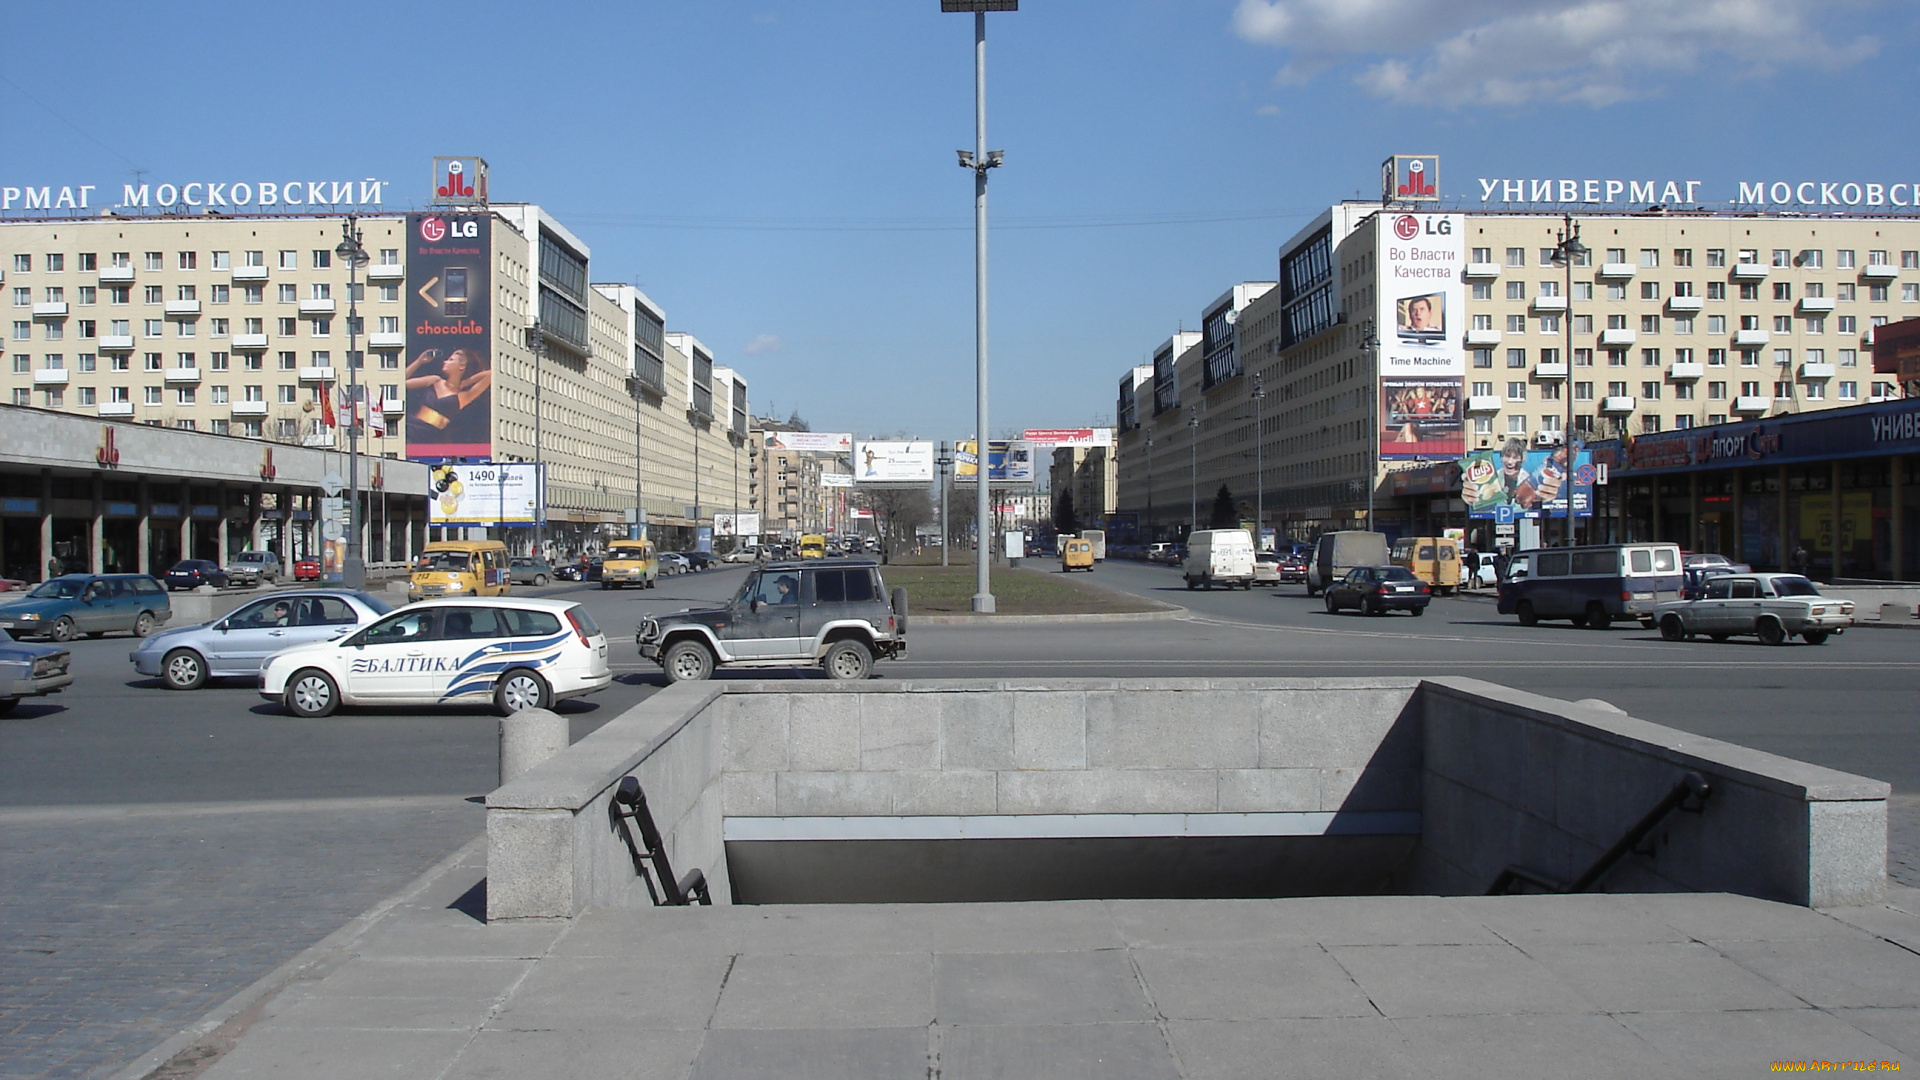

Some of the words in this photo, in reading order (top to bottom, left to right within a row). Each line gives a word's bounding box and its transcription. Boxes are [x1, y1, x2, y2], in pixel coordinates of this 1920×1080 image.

[2, 185, 96, 210] РМАГ
[1478, 178, 1701, 204] УНИВЕРМАГ
[451, 221, 478, 238] LG
[1425, 220, 1452, 235] LG
[1390, 247, 1406, 261] Во
[1411, 247, 1455, 261] Власти
[1394, 265, 1451, 278] Качества
[416, 320, 483, 335] chocolate
[1389, 357, 1411, 366] Time
[1413, 357, 1452, 366] Machine
[1067, 435, 1094, 443] Audi
[469, 470, 495, 481] 1490
[367, 657, 461, 673] БАЛТИКА
